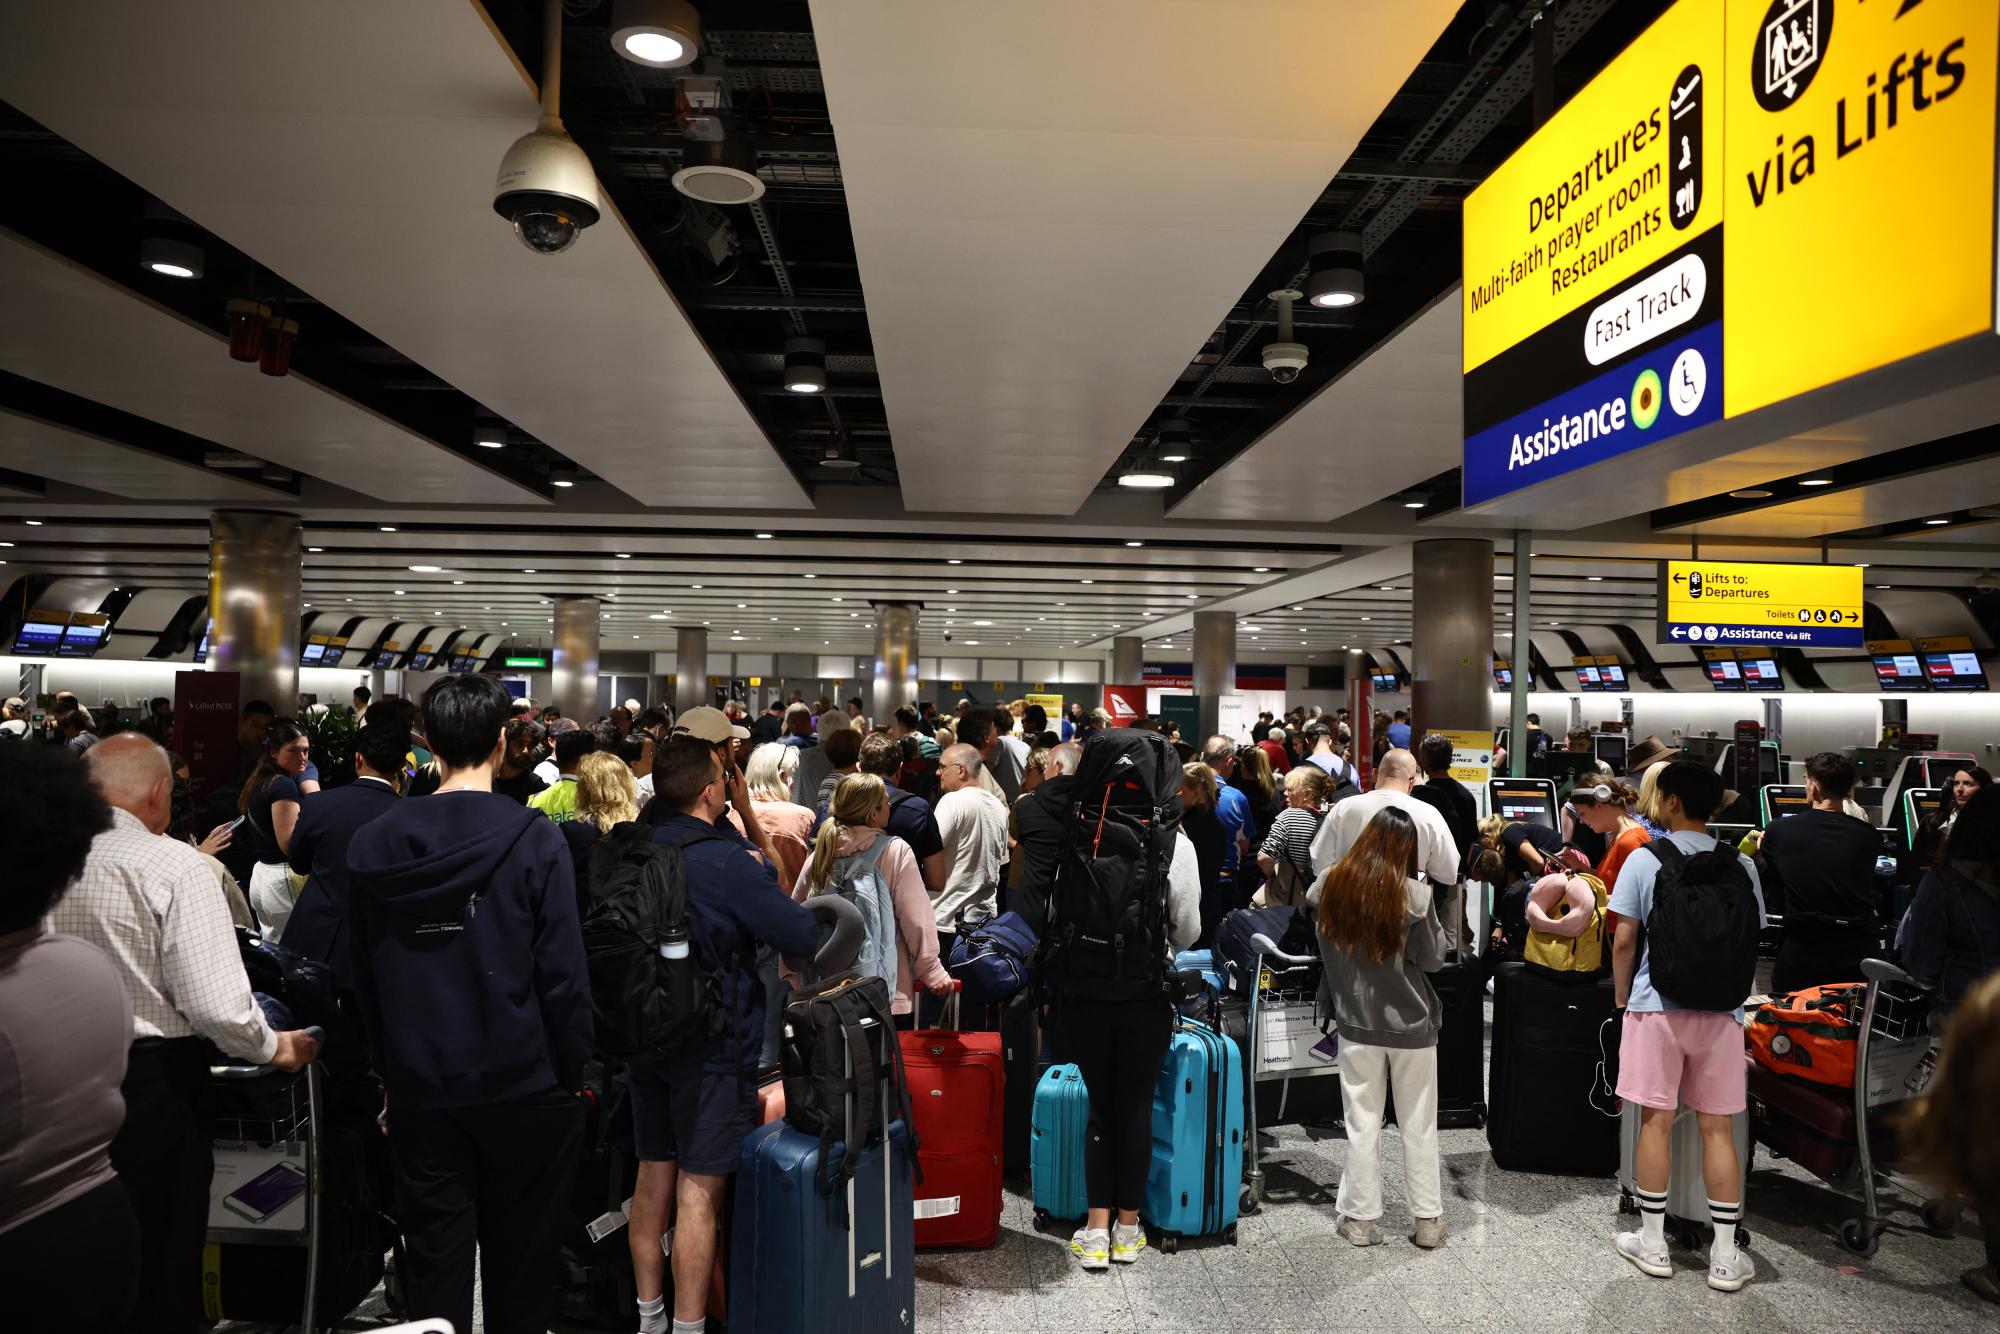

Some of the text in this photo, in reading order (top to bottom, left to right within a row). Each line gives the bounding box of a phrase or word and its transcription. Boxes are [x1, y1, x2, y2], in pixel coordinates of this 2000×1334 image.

[1747, 38, 1965, 207] via Lifts
[1529, 106, 1661, 233] Departures
[1471, 164, 1661, 314] Multi-faith prayer room
[1552, 205, 1661, 296] Restaurants
[1595, 275, 1692, 346] Fast Track
[1509, 396, 1627, 471] Assistance
[1705, 574, 1748, 584] Lifts to:
[1705, 588, 1769, 599] Departures
[1767, 610, 1795, 619] Toilets
[1720, 627, 1784, 639] Assistance
[1799, 632, 1811, 640] lift
